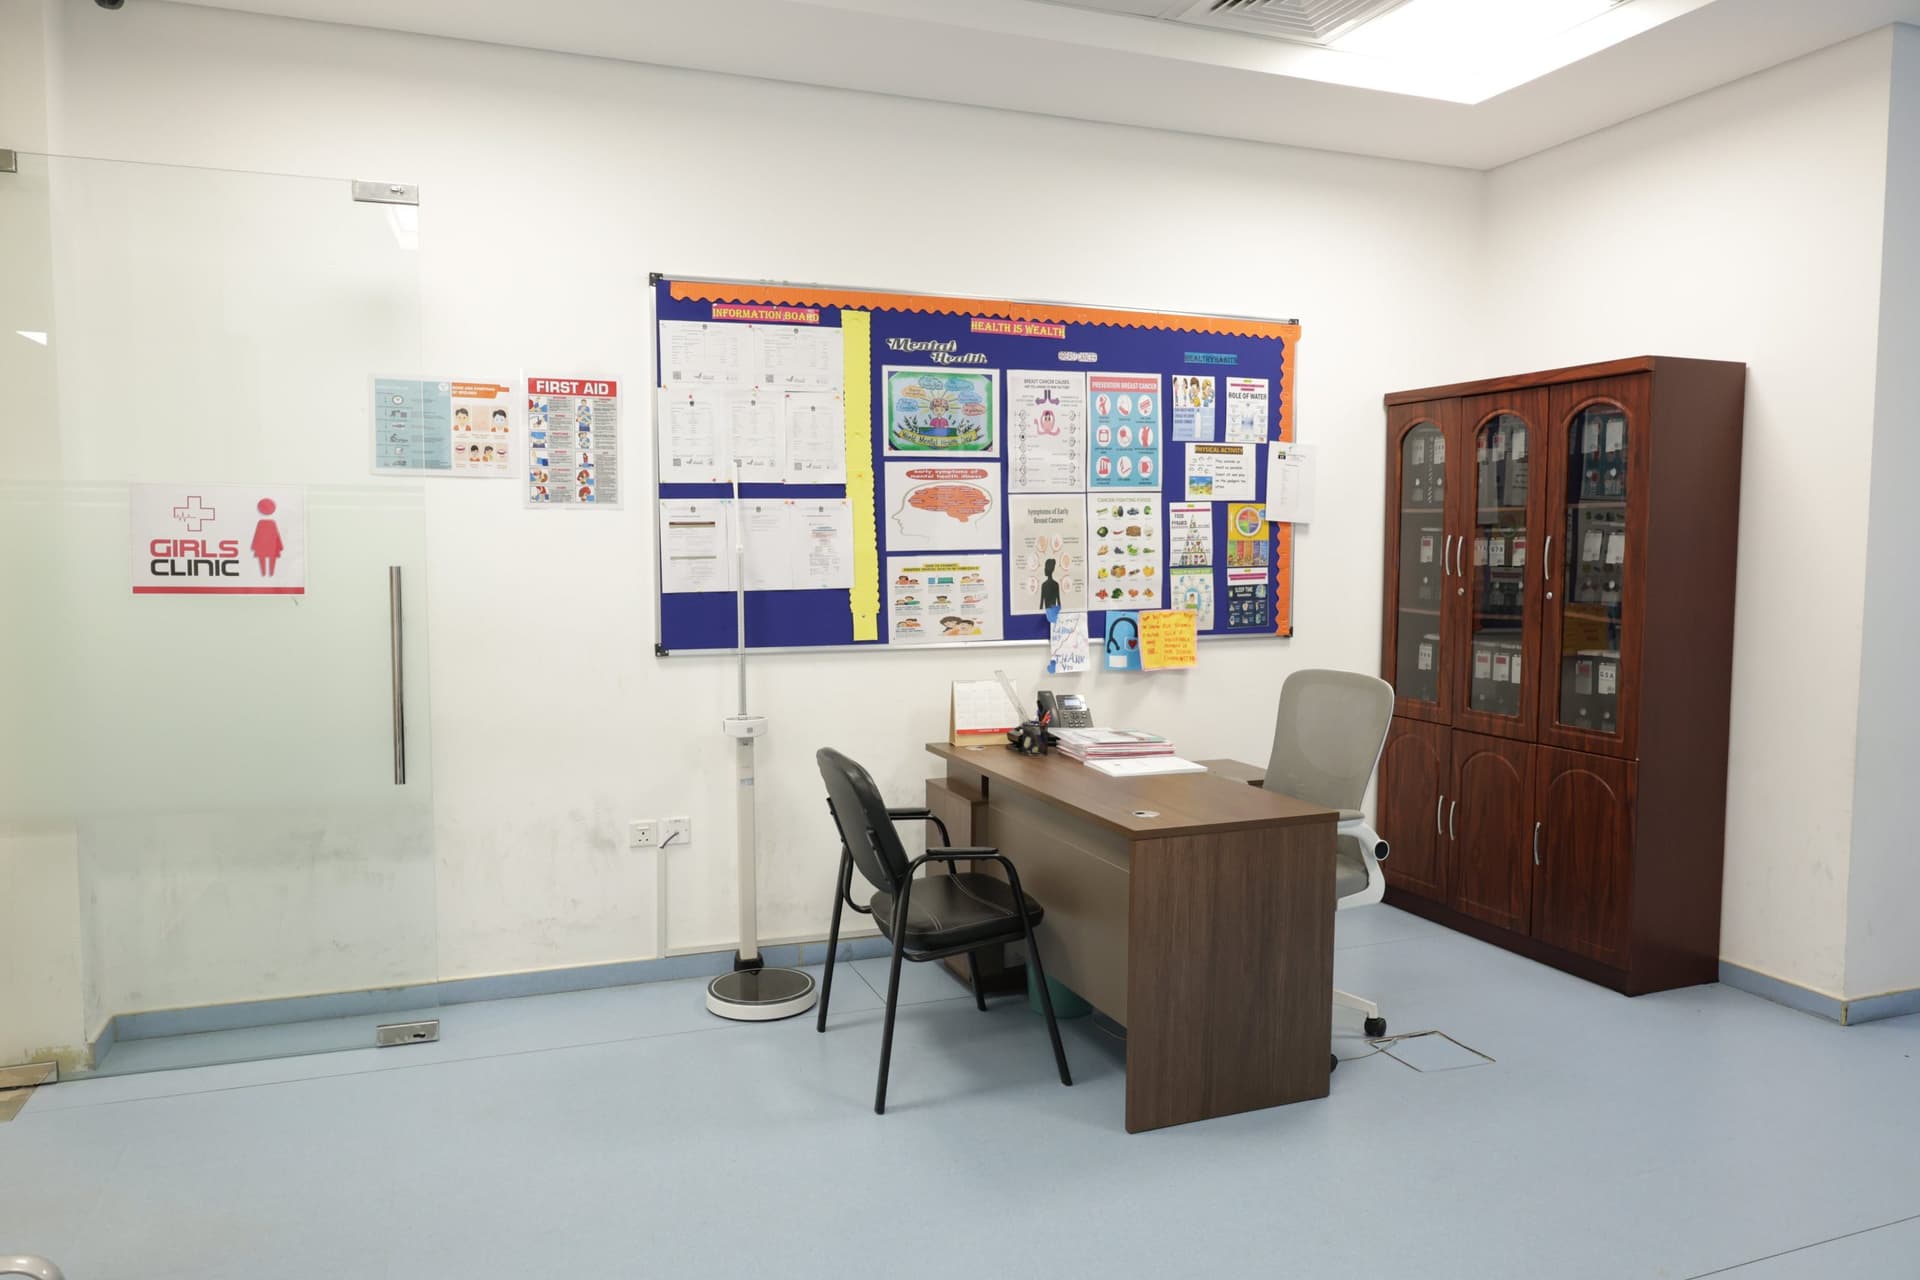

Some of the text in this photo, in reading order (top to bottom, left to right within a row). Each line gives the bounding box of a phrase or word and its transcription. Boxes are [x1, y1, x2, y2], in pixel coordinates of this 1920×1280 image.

[712, 308, 819, 322] INFORMATION BOARD
[971, 320, 1066, 338] HEALTH IS WEALTH
[886, 338, 957, 352] Mental
[931, 351, 988, 364] Health
[536, 380, 609, 395] FIRST AID
[1250, 393, 1267, 401] WATER
[150, 539, 239, 558] GIRLS
[150, 559, 240, 576] CLINIC
